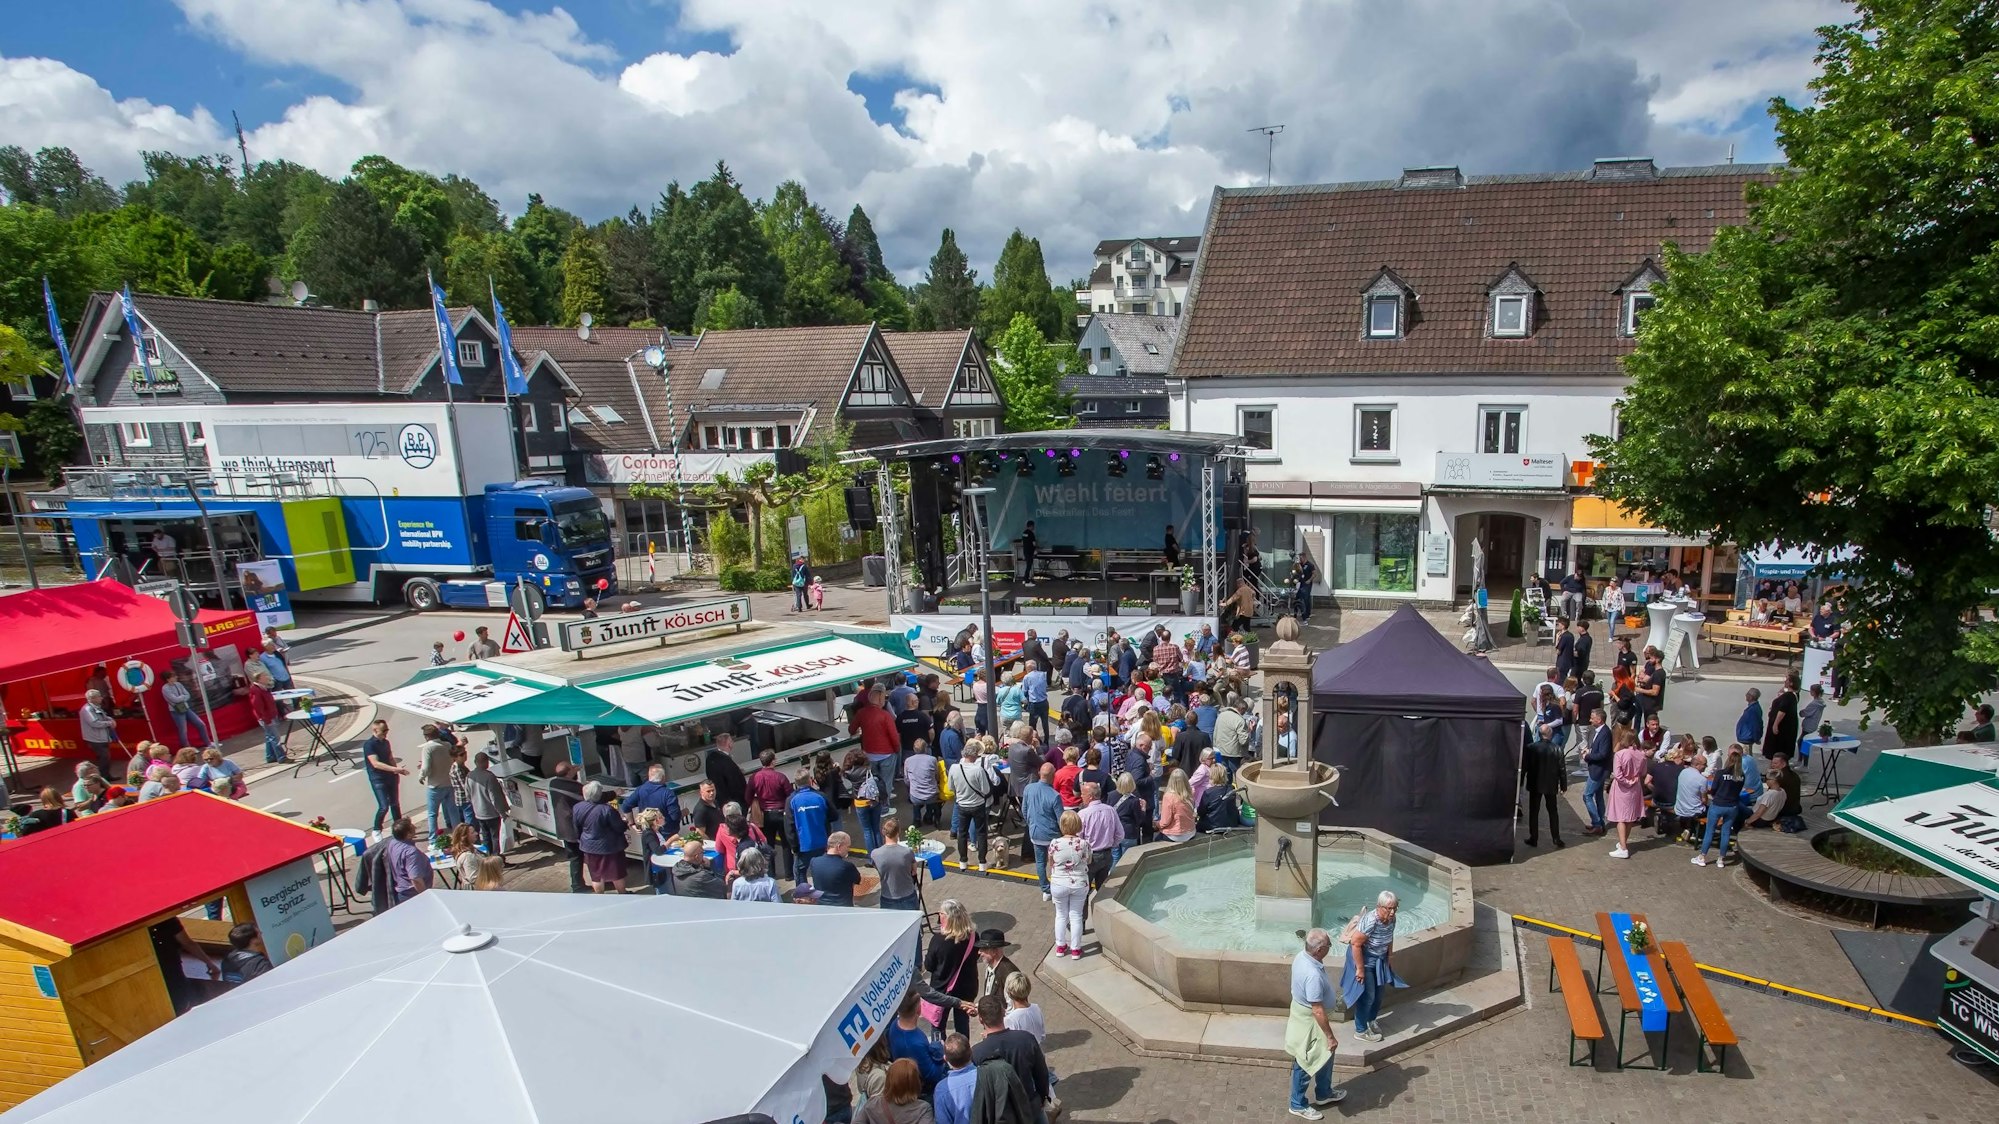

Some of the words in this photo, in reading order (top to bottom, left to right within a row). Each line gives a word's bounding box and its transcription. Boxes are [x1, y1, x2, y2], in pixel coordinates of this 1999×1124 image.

[354, 431, 389, 460] 125
[221, 460, 240, 472] we
[242, 456, 276, 473] think
[278, 457, 336, 476] transport
[1034, 482, 1099, 504] Wiehl
[1104, 482, 1168, 502] feiert
[599, 616, 661, 641] Zunft
[664, 609, 725, 630] KÖLSCH
[656, 671, 764, 702] Zunft
[766, 655, 854, 678] KÖLSCH
[25, 738, 77, 750] DLRG
[260, 875, 312, 908] Bergischer
[277, 893, 306, 914] Sprizz
[861, 954, 903, 1007] Volksbank
[871, 973, 908, 1023] Oberberg
[1949, 997, 1970, 1022] TC
[1973, 1011, 1999, 1041] Wie
